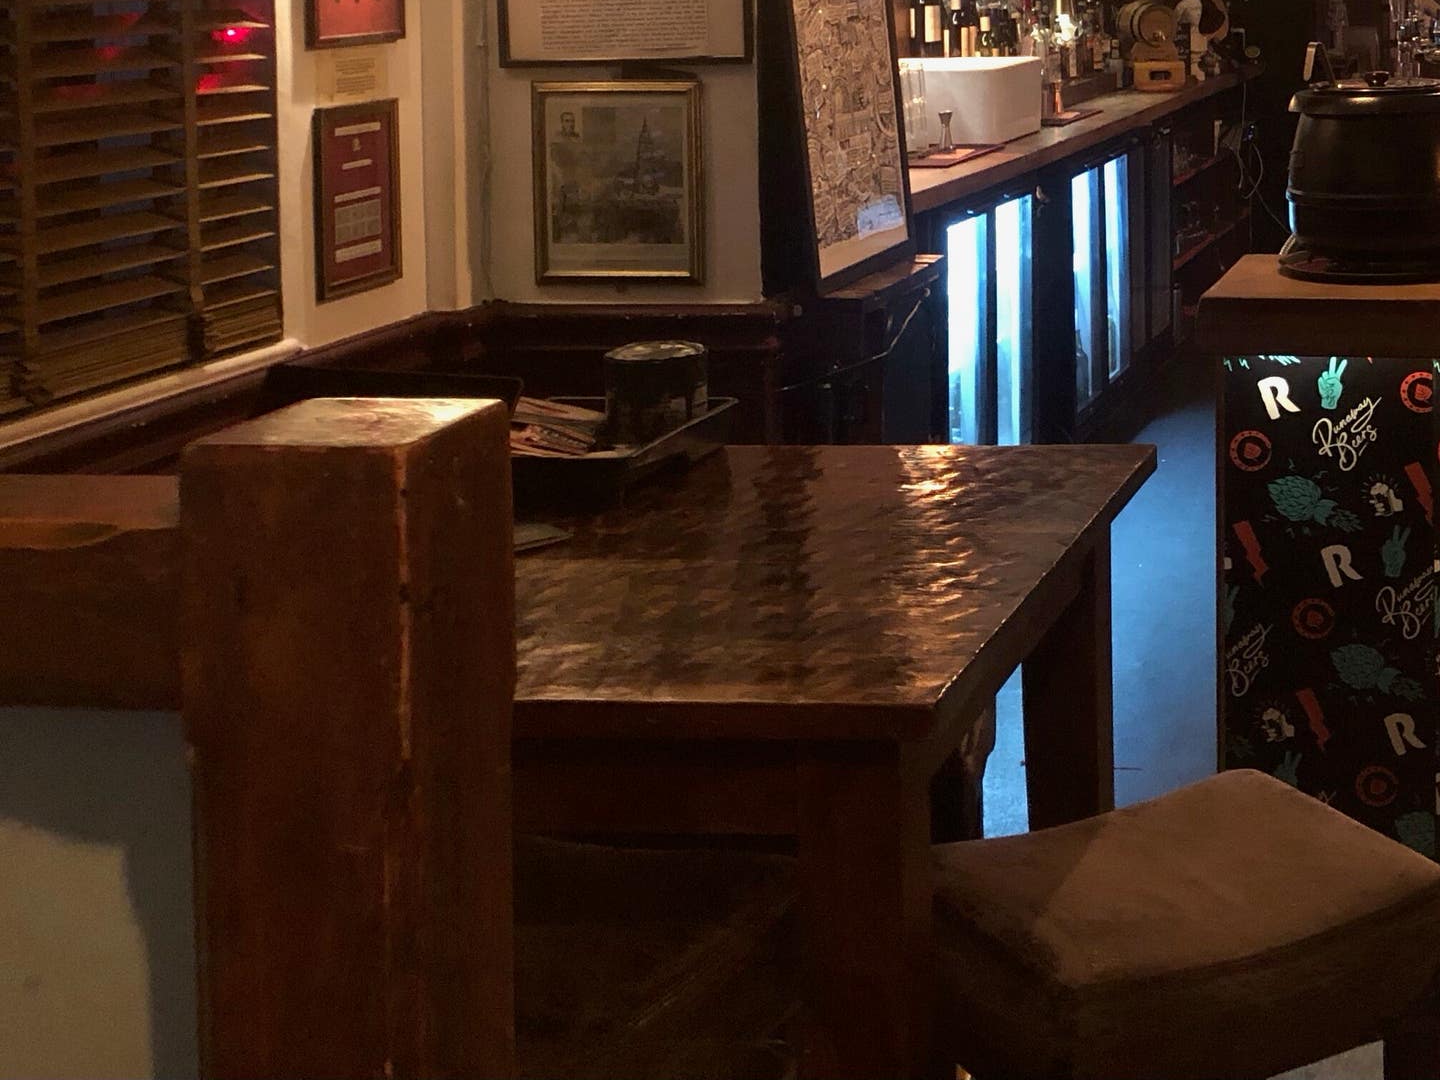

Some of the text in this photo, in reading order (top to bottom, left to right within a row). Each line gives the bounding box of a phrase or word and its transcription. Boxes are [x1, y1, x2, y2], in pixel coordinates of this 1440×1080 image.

[1257, 376, 1301, 420] R
[1312, 397, 1383, 457] Runaway
[1336, 424, 1378, 472] Beers
[1320, 544, 1364, 588] R
[1226, 624, 1273, 660] unaway
[1383, 712, 1427, 756] R
